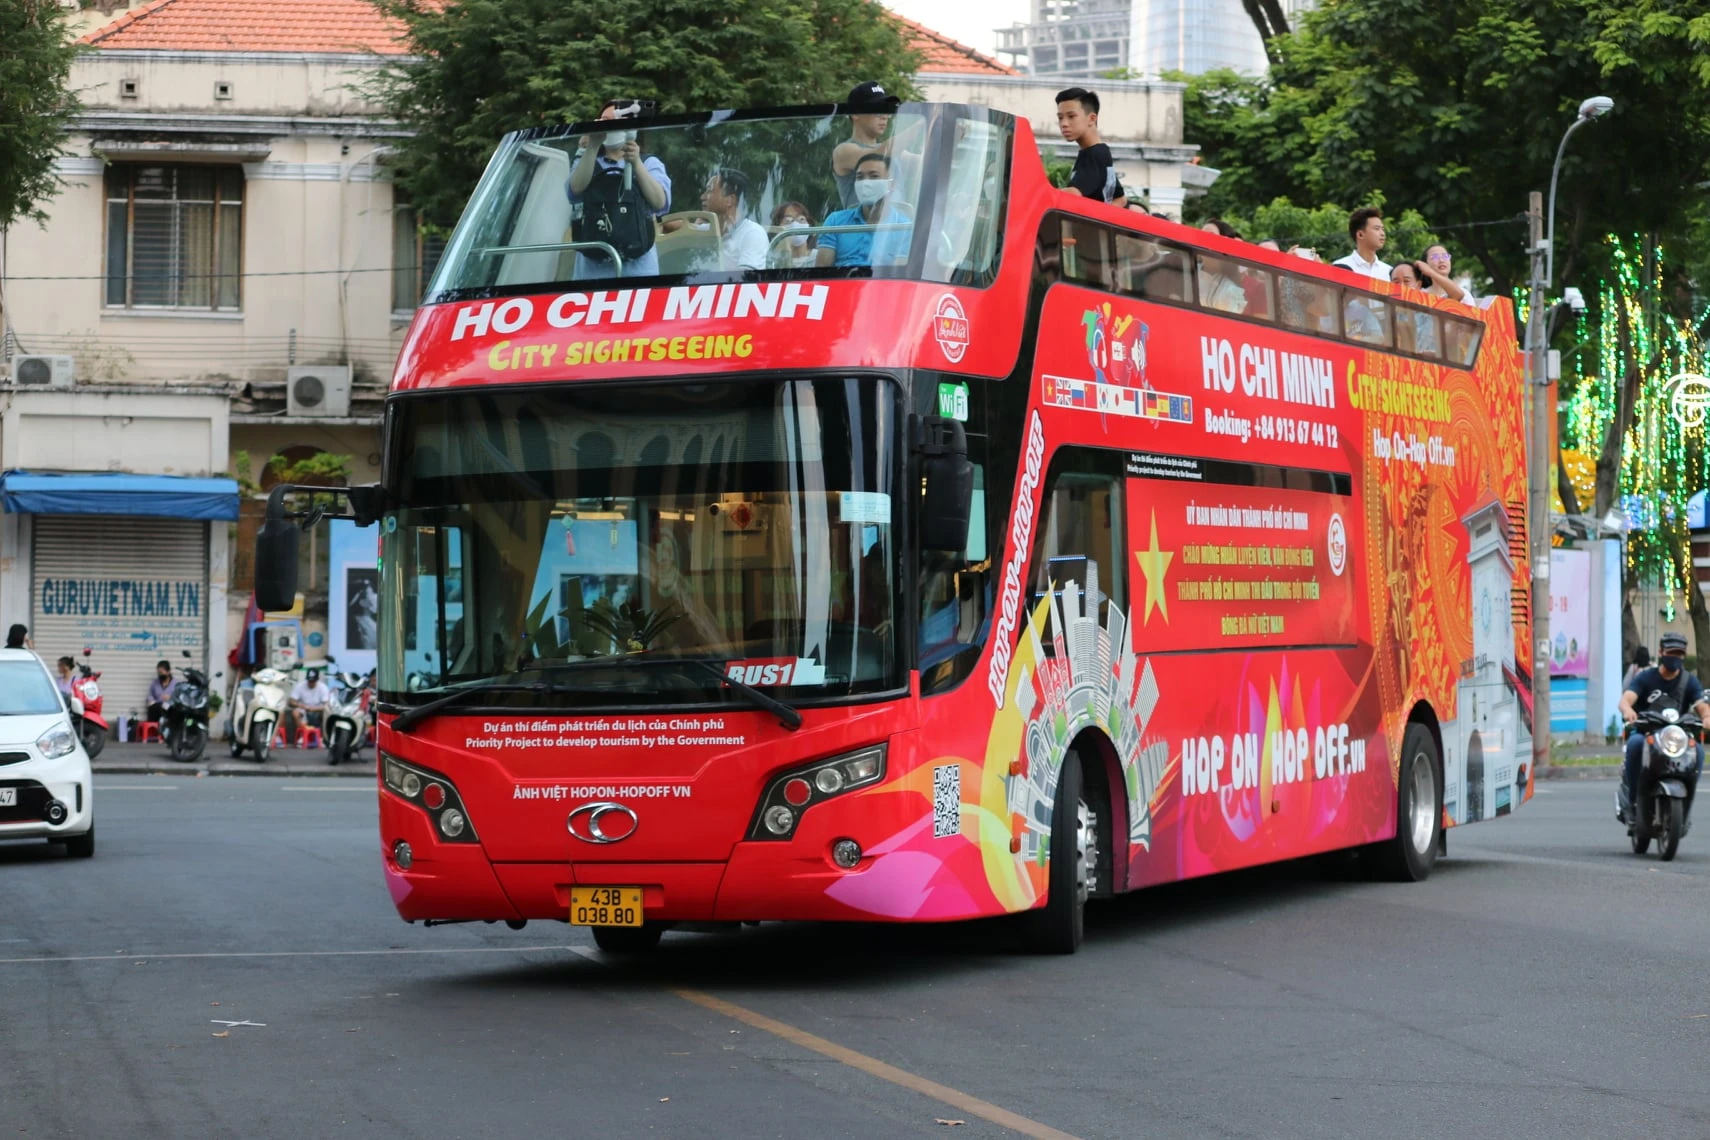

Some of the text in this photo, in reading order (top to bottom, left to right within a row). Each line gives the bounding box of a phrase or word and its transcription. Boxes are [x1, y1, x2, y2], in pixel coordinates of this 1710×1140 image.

[450, 283, 830, 341] HO CHI MINH
[564, 334, 753, 366] SIGHTSEEING
[1200, 336, 1336, 409] HO CHI MINH
[1381, 379, 1452, 424] SIGHTSEEING
[1204, 407, 1338, 449] Booking: +84 913 67 44 12
[1373, 428, 1456, 470] Hop On-Hop Off.vn
[42, 578, 200, 617] GURUVIETNAM.VN
[466, 735, 745, 750] Priority Project to develop tourism by the Government
[484, 718, 725, 735] Dự án thí điểm phát triển du lịch của Chính phủ
[1182, 723, 1366, 796] HOP ON HOP OFF.VN
[513, 785, 691, 801] ẢNH VIỆT HOPON-HOPOFF VN
[577, 907, 634, 924] 038.80
[590, 890, 621, 906] 43B
